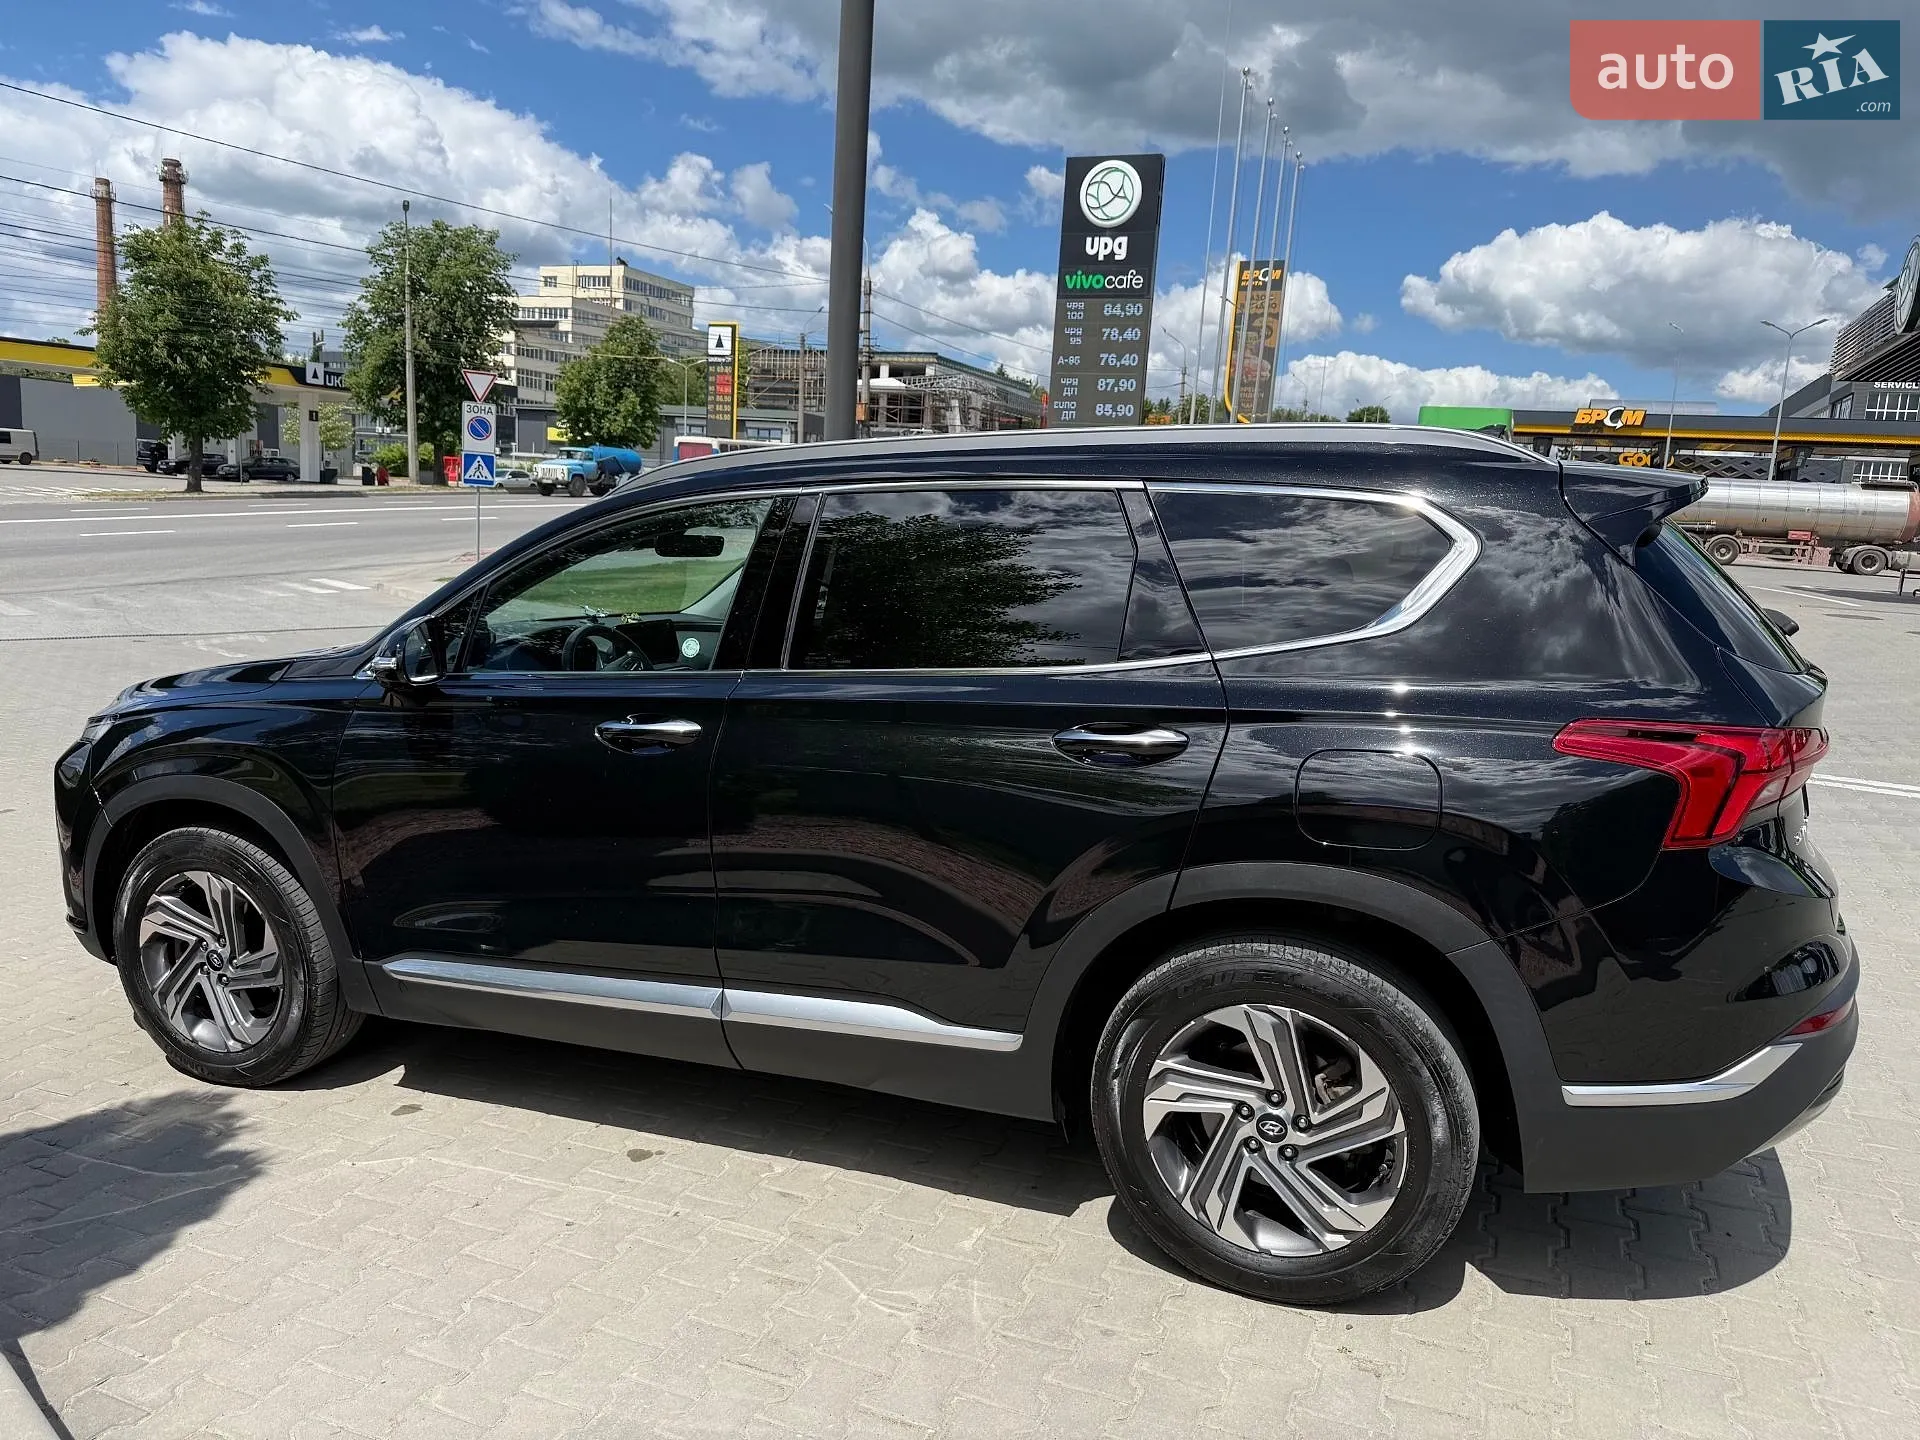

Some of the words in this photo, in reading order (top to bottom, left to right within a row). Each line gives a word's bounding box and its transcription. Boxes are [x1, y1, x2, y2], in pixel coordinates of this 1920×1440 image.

[1085, 236, 1128, 261] upg
[1067, 311, 1084, 320] 100
[1103, 303, 1143, 318] 84,90
[1102, 327, 1141, 343] 78,40
[1099, 353, 1139, 368] 76,40
[1096, 378, 1137, 393] 87,90
[466, 405, 493, 415] ЗОНА
[1095, 403, 1134, 418] 85,90
[1574, 406, 1645, 430] БРСМ
